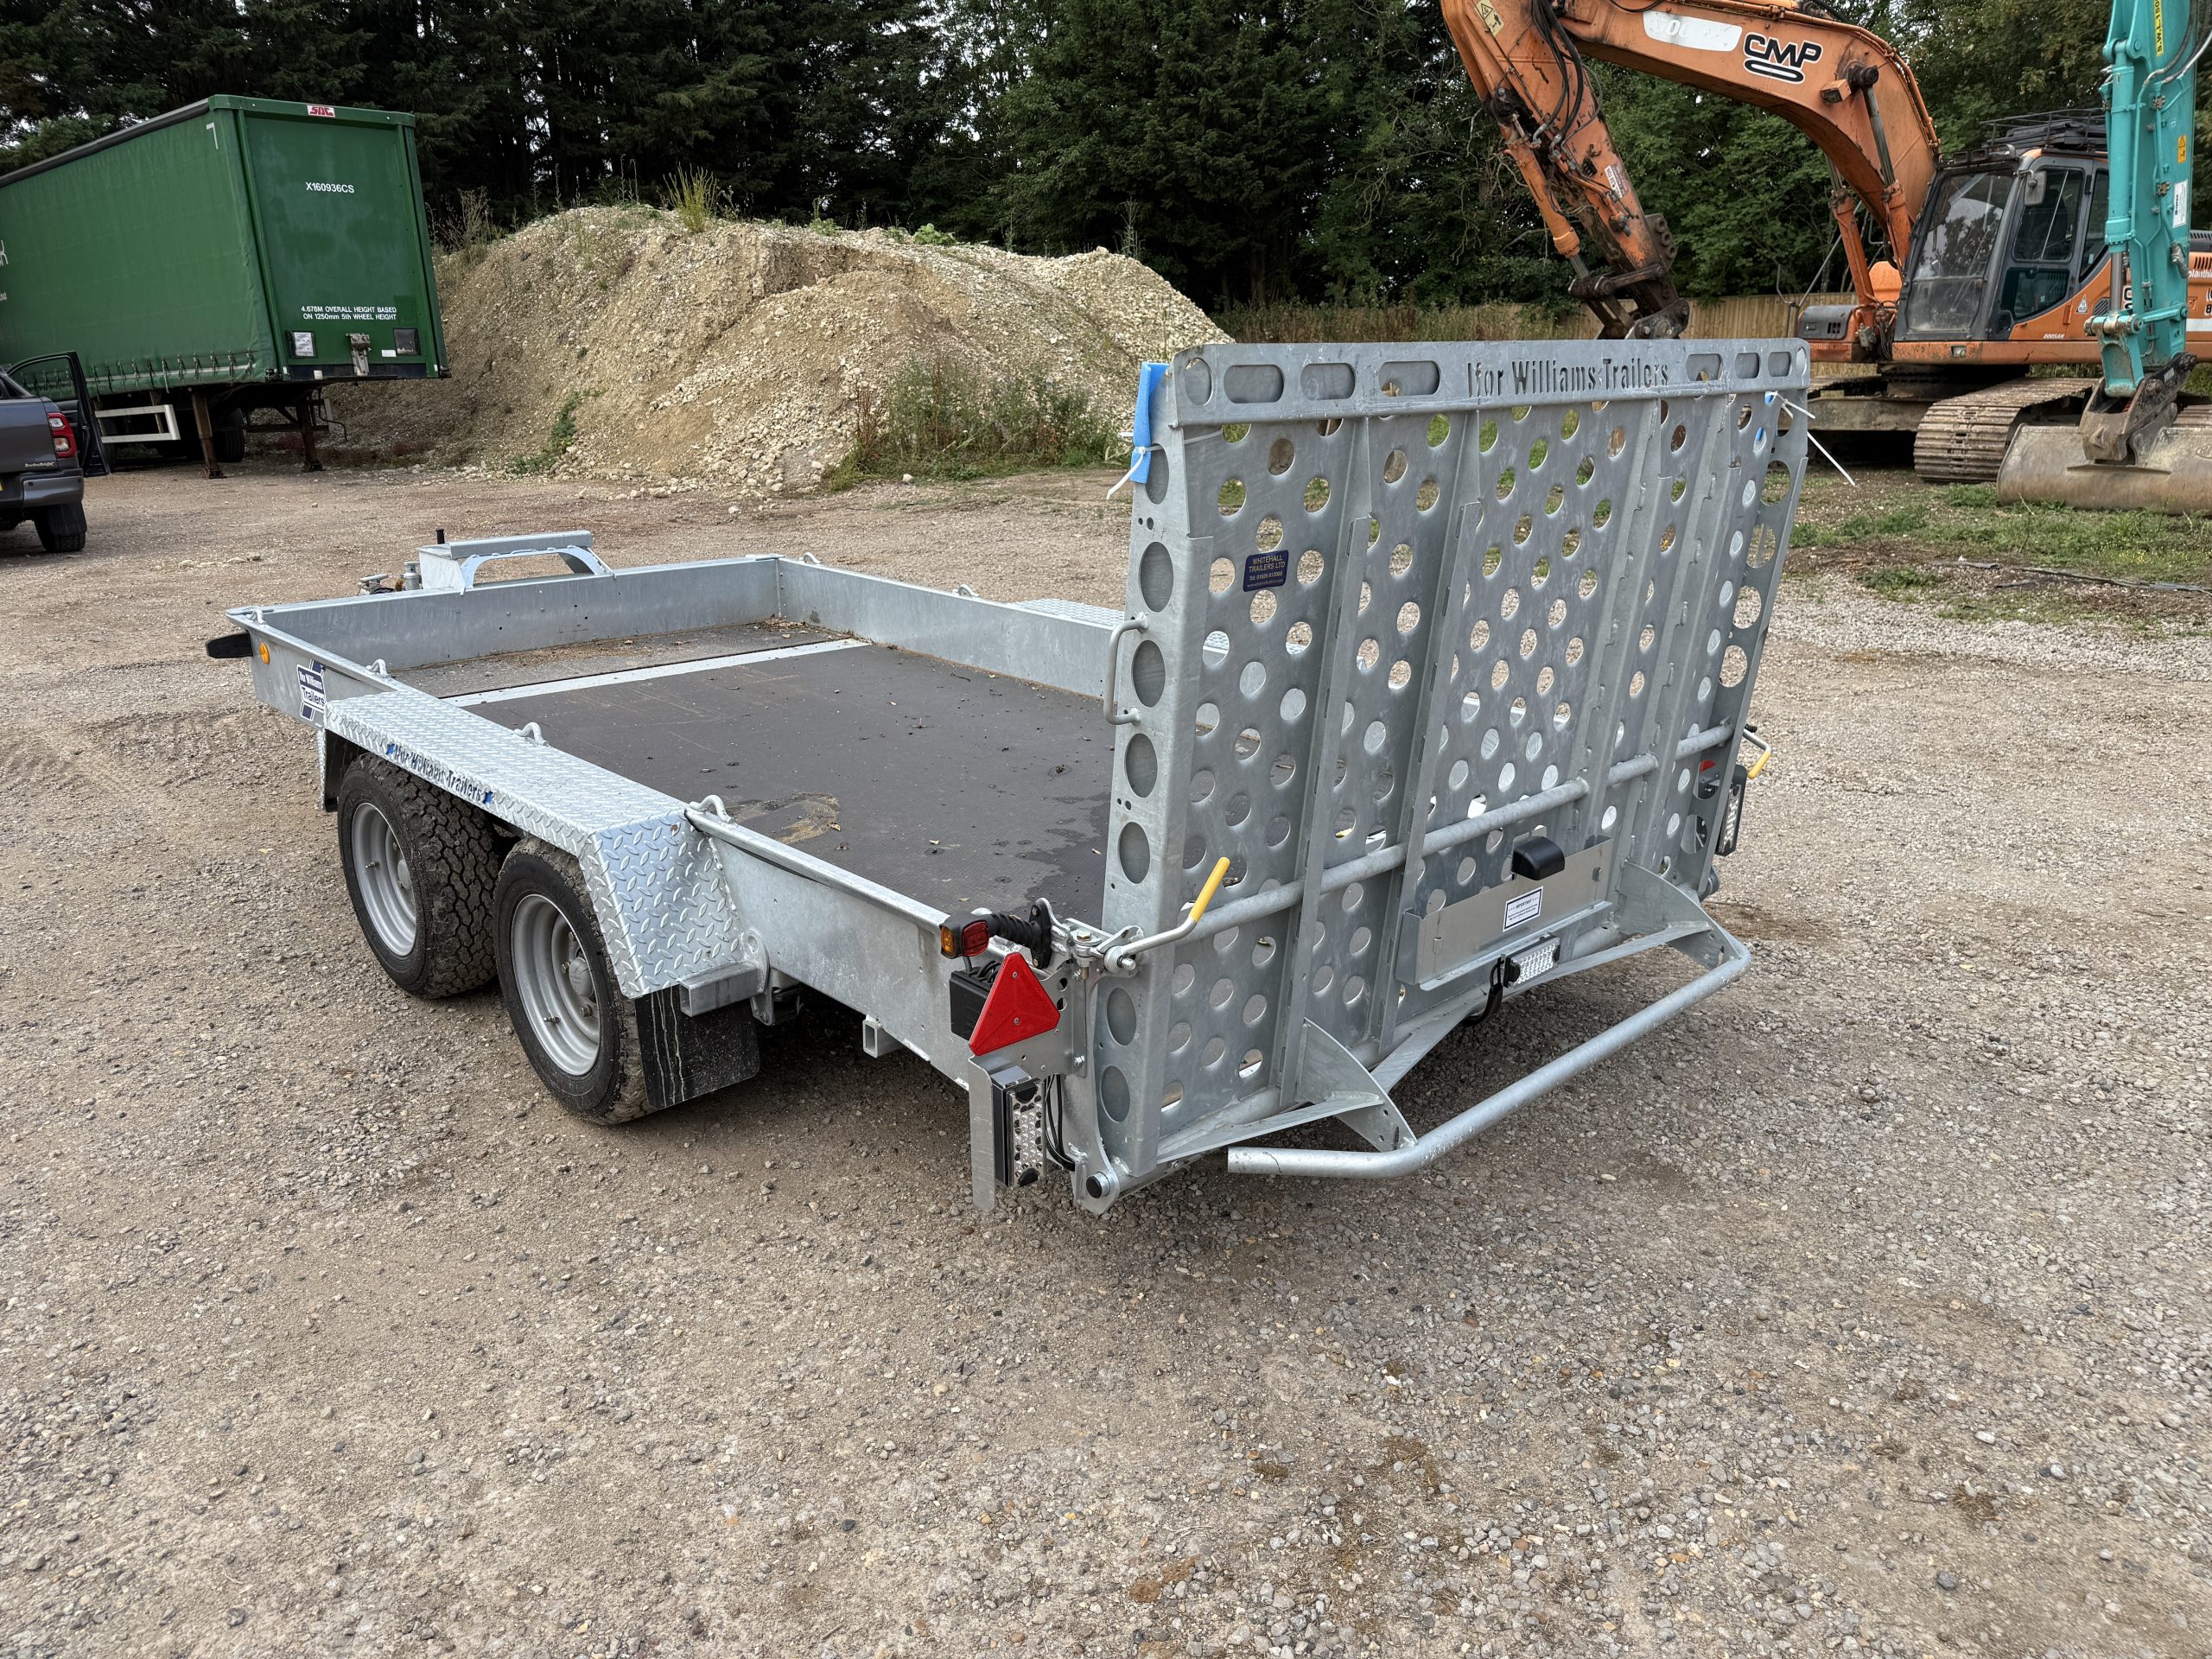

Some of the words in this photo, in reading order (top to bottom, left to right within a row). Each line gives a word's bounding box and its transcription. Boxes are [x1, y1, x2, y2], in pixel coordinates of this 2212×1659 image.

[1744, 32, 1822, 69] CMP
[305, 181, 355, 194] X160936CS
[1467, 361, 1504, 397] Ifor
[1512, 360, 1597, 395] Williams
[1603, 358, 1669, 390] Trailers
[1249, 563, 1274, 573] TRAILERS
[1253, 555, 1283, 565] WHITEHALL
[302, 686, 325, 707] Trailers
[447, 769, 483, 801] Trailers
